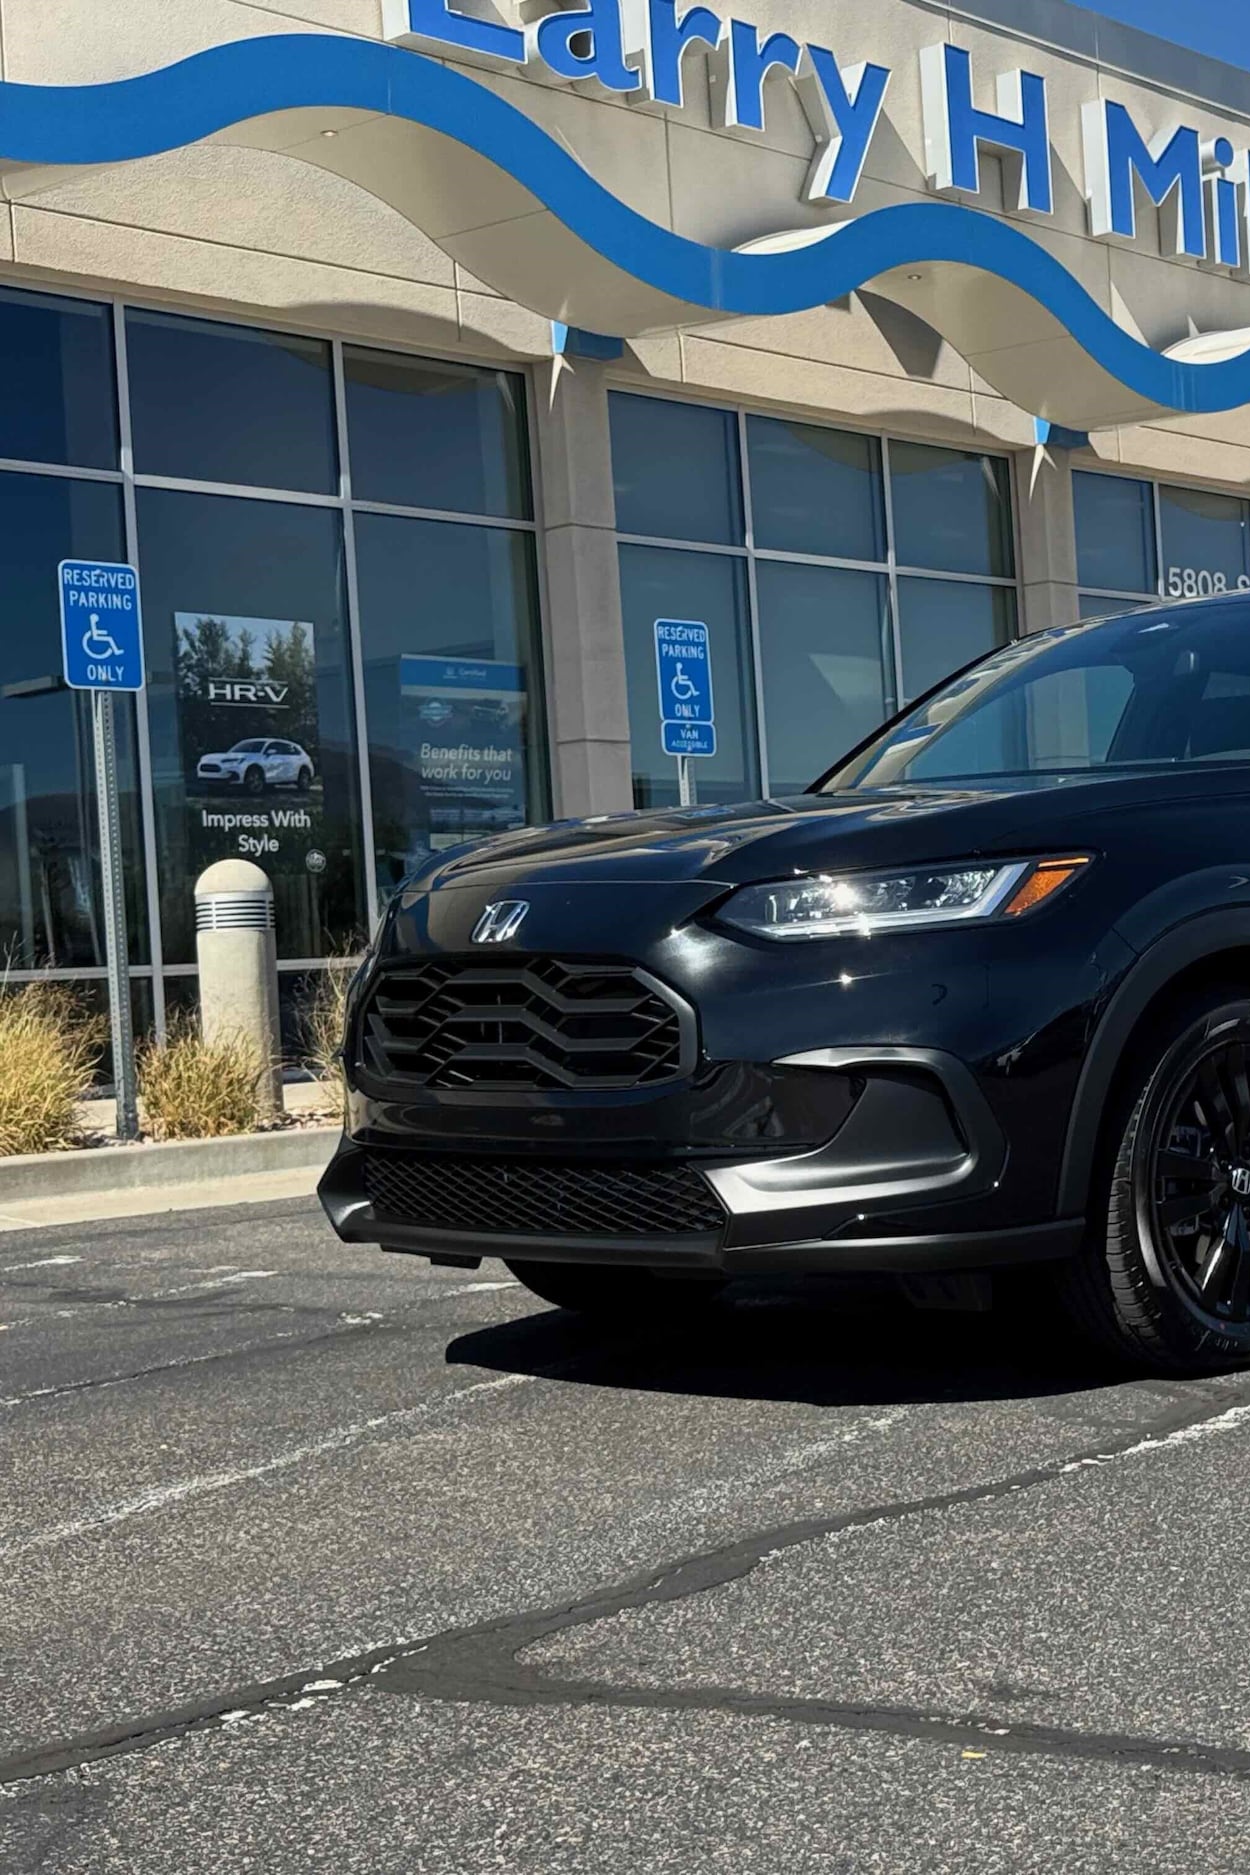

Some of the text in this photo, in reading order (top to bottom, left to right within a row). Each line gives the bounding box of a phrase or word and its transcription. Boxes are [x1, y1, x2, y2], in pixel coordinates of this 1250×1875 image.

[940, 42, 1054, 216] H
[63, 568, 135, 589] RESERVED
[1168, 567, 1227, 597] 5808
[69, 590, 132, 610] PARKING
[657, 625, 705, 642] RESERVED
[661, 643, 704, 659] PARKING
[86, 664, 124, 682] ONLY
[208, 682, 289, 703] HR-V
[674, 703, 700, 718] ONLY
[680, 729, 699, 740] VAN
[420, 743, 513, 762] Benefits that
[421, 763, 512, 784] work for you
[202, 809, 311, 832] Impress With
[238, 833, 280, 857] Style
